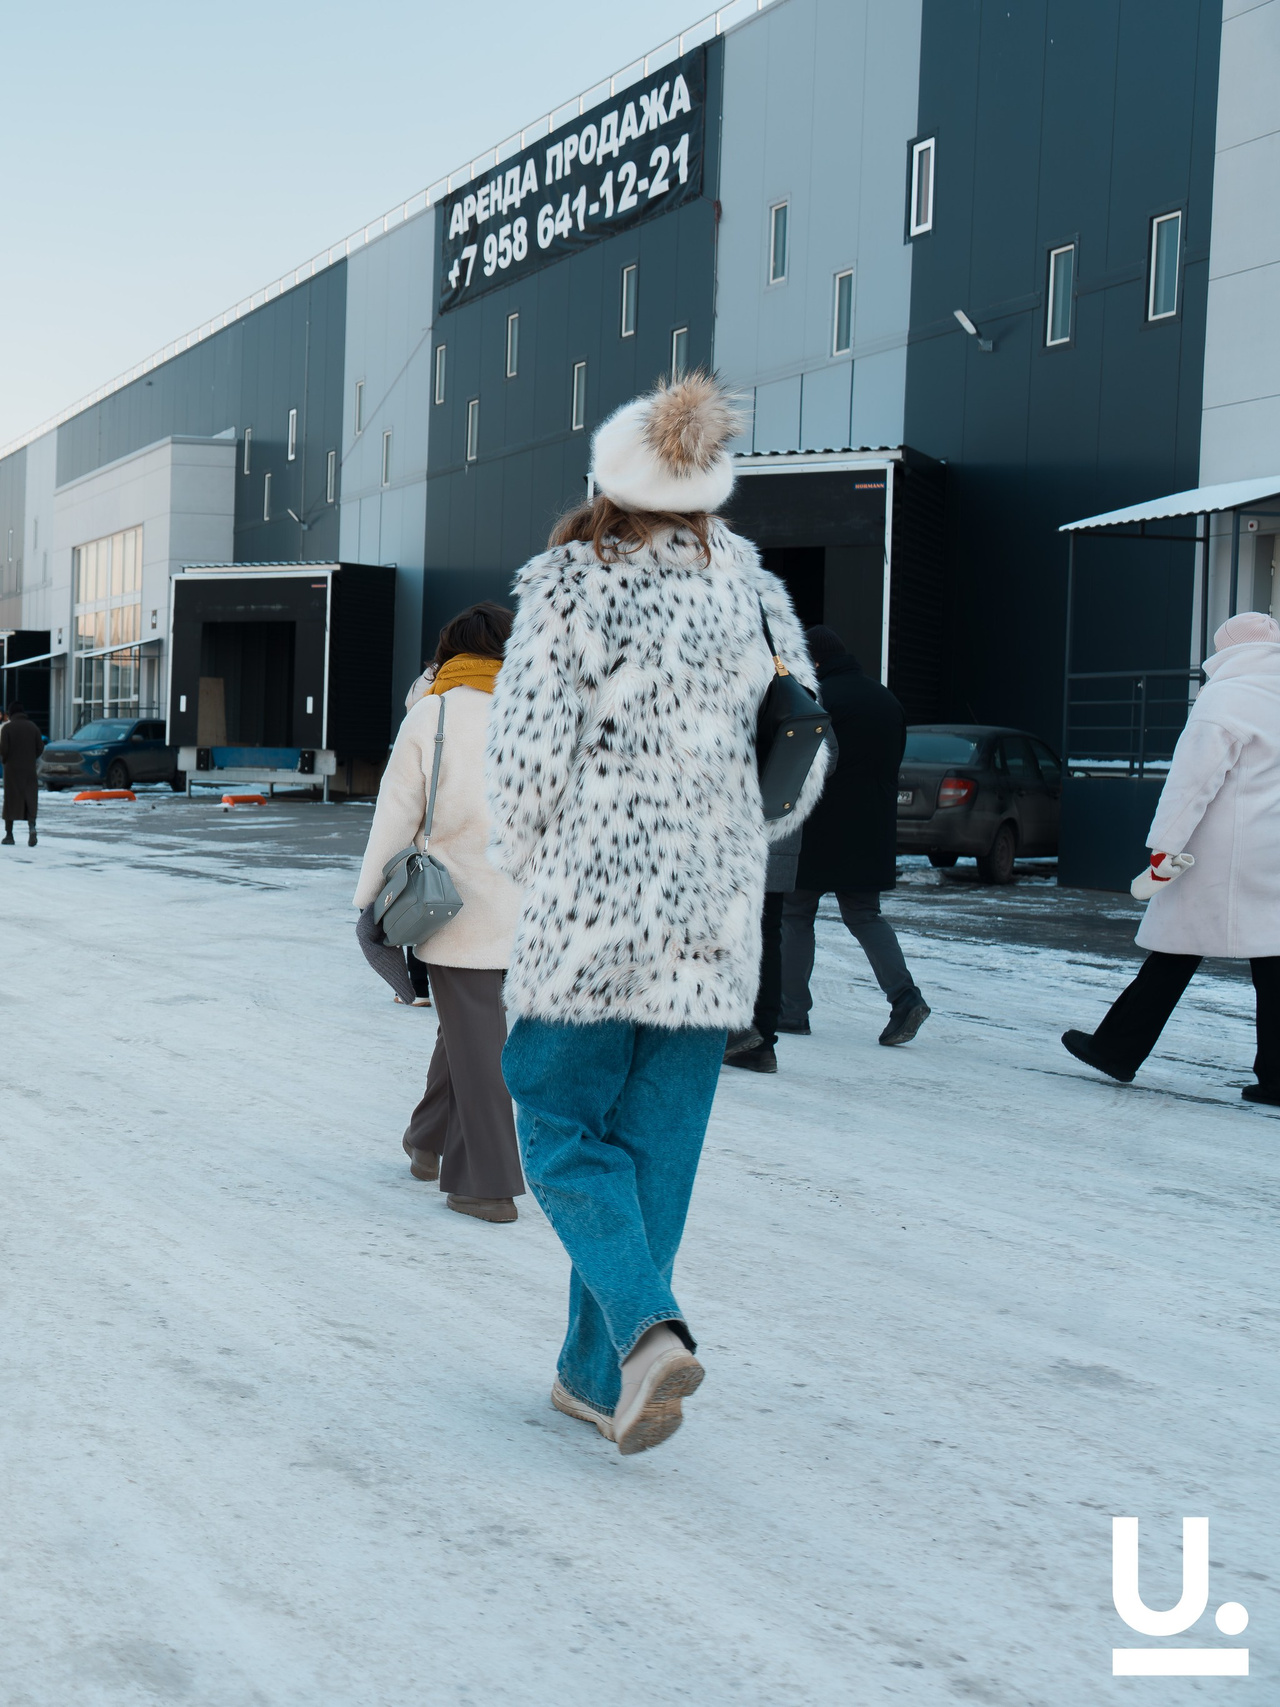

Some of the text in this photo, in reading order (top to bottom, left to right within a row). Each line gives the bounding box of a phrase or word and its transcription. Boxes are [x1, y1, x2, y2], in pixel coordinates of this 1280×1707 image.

[447, 132, 690, 289] +7 958 641-12-21
[448, 73, 692, 240] АРЕНДА ПРОДАЖА
